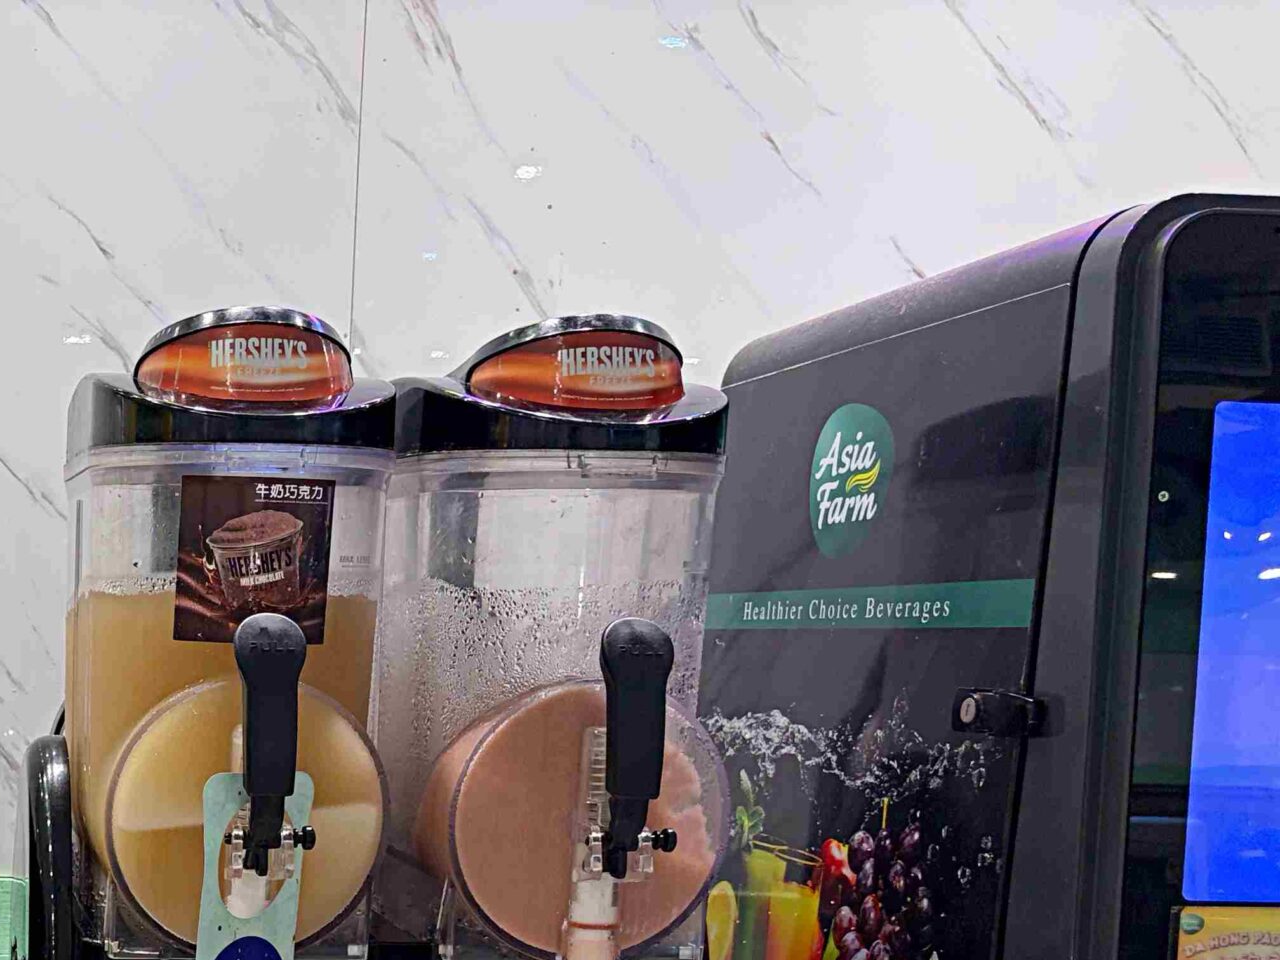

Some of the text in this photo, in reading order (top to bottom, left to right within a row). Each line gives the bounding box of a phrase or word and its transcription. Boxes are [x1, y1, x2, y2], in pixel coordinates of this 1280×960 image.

[210, 337, 308, 369] HERSHEY'S
[560, 346, 656, 378] HERSHEY'S
[815, 431, 877, 480] Asia
[255, 482, 324, 501] 牛奶巧克力
[816, 480, 878, 530] Farm
[743, 597, 951, 624] Healthier Choice Beverages
[248, 640, 297, 653] PULL
[616, 643, 665, 656] PULL
